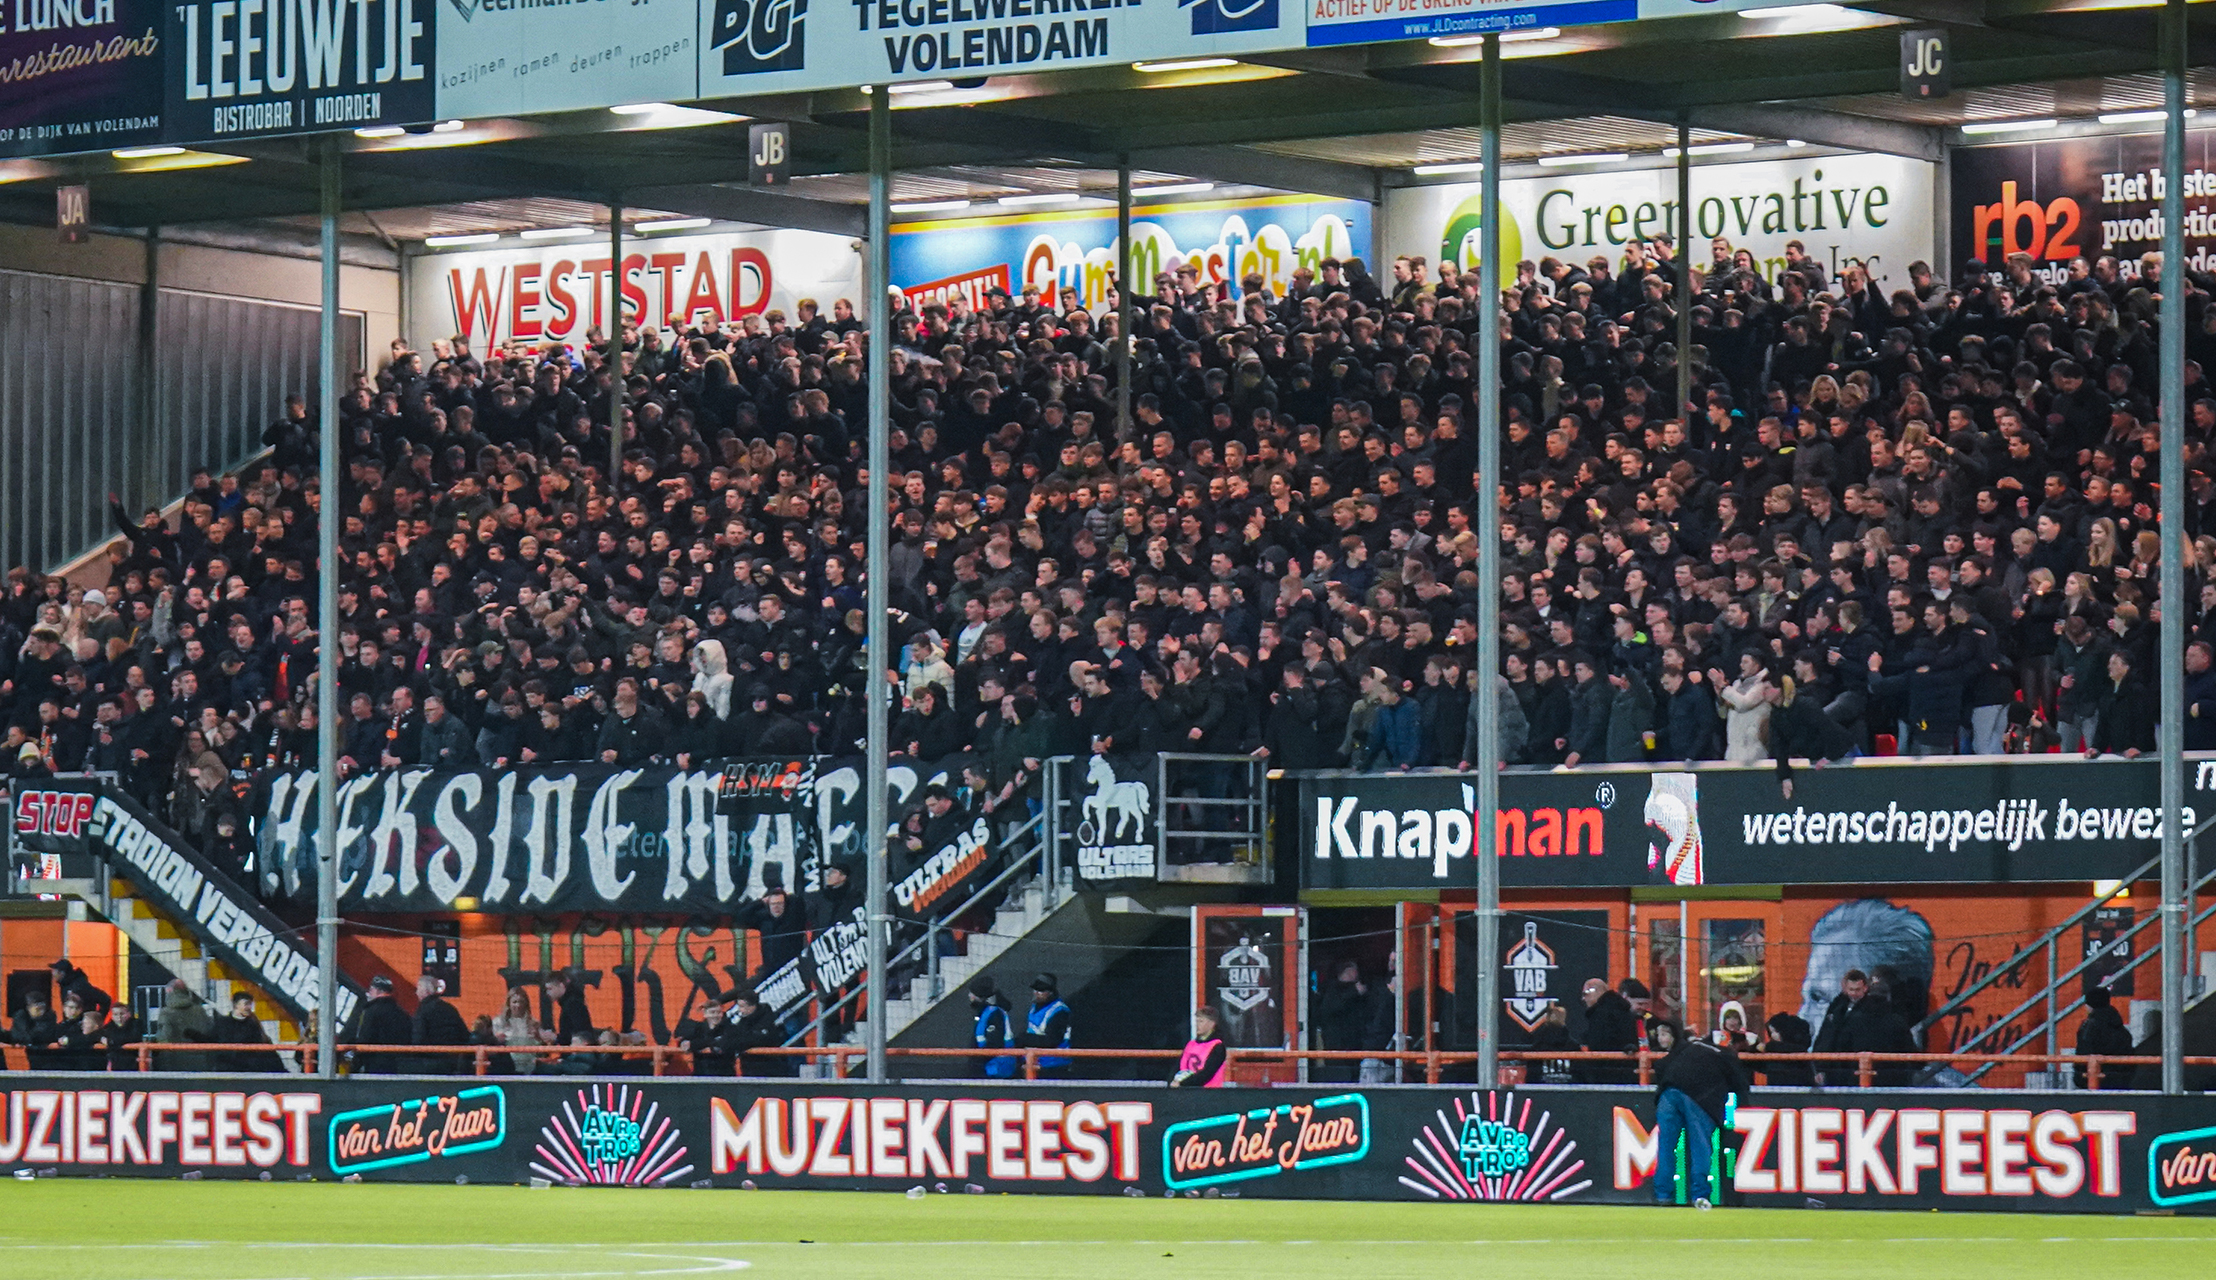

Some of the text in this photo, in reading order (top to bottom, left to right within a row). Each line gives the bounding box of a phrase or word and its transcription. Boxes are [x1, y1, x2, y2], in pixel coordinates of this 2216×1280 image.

[15, 0, 116, 33] LUNCH
[853, 0, 1143, 31] TEGELWE
[1315, 0, 1368, 19] ACTIEF
[1403, 12, 1537, 35] www.JLDcontracting.com
[185, 0, 425, 100] LEEUWTJE
[442, 37, 691, 89] kozijnen ramen deuren trappen
[885, 18, 1108, 74] VOLENDAM
[1908, 38, 1943, 77] JC
[19, 126, 32, 140] DE
[38, 124, 63, 139] DIJK
[67, 121, 91, 136] VAN
[95, 115, 160, 133] VOLENDAM
[213, 93, 382, 134] BISTROBAR NOORDEN
[754, 131, 785, 166] JB
[61, 195, 86, 227] JA
[1536, 169, 1888, 250] Greenovative
[2101, 168, 2216, 203] Het bste
[1973, 180, 2082, 264] rb2
[448, 247, 773, 356] WESTSTAD
[16, 789, 97, 840] STOP
[1743, 798, 2046, 852] wetenschappelijk
[894, 817, 990, 907] ULTRAS
[88, 796, 359, 1035] STADION VERBODE!!
[1513, 968, 1547, 993] VAB
[338, 1122, 383, 1159] van
[384, 1100, 424, 1150] het
[710, 1096, 1153, 1183] MUZIEKFEEST
[1174, 1133, 1226, 1173] van
[1228, 1109, 1274, 1163] het
[1612, 1104, 2138, 1198] MZIEKFEEST
[2161, 1145, 2216, 1189] van
